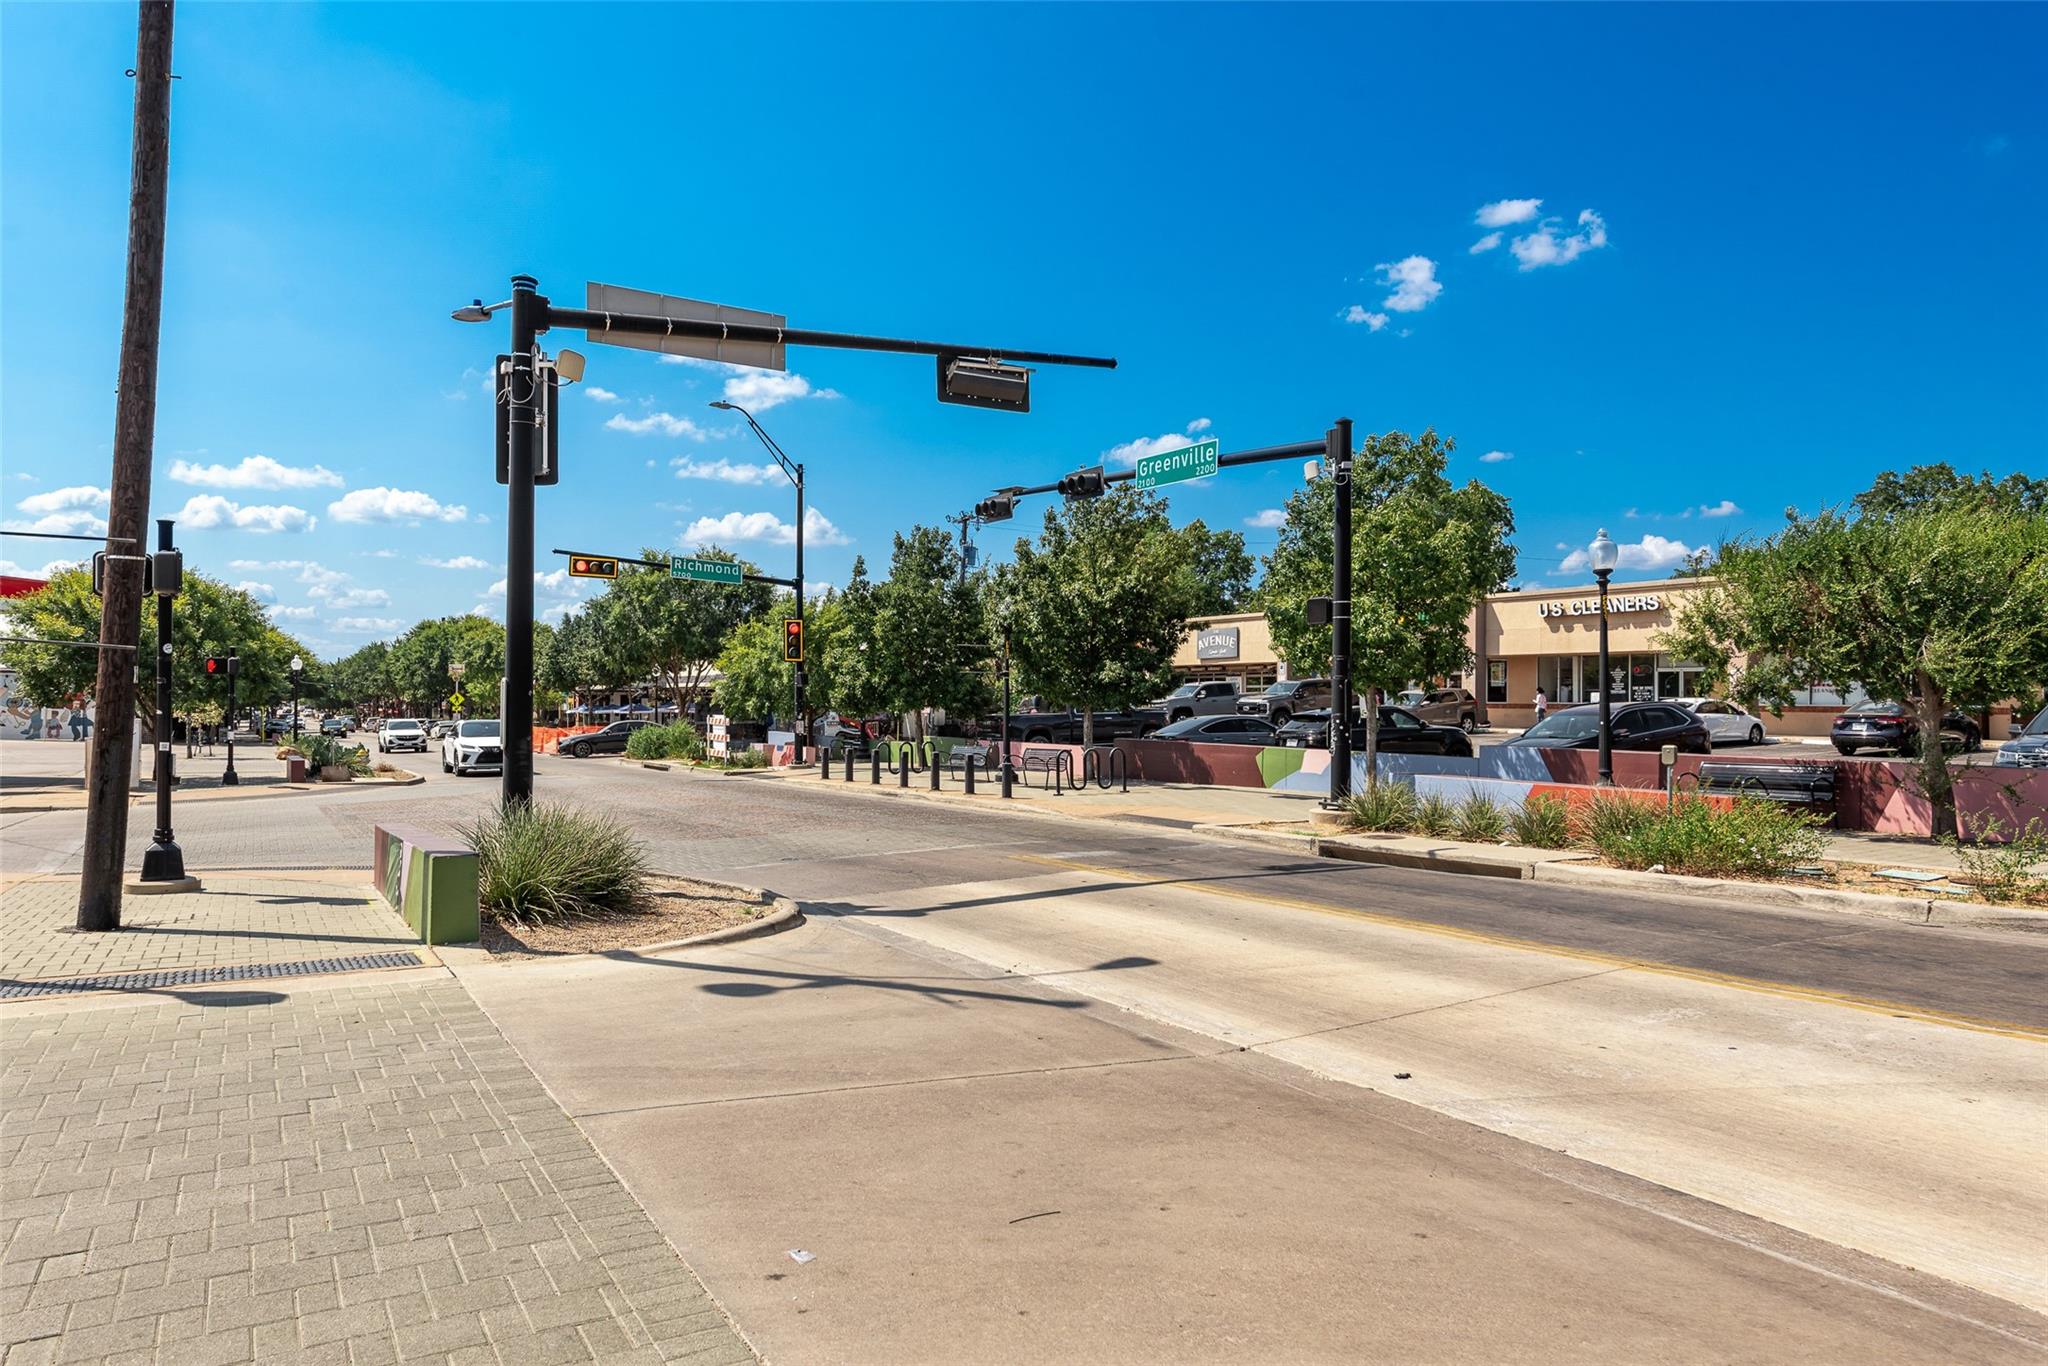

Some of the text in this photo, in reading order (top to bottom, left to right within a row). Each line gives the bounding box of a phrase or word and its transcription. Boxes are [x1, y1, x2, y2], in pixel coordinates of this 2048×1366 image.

[1140, 446, 1214, 476] Greenville
[1195, 463, 1215, 476] 2200
[1137, 477, 1156, 489] 2100
[674, 558, 739, 576] Richmond
[1538, 602, 1564, 617] US
[1570, 595, 1659, 616] CLEANERS
[1198, 634, 1237, 650] AVENUE
